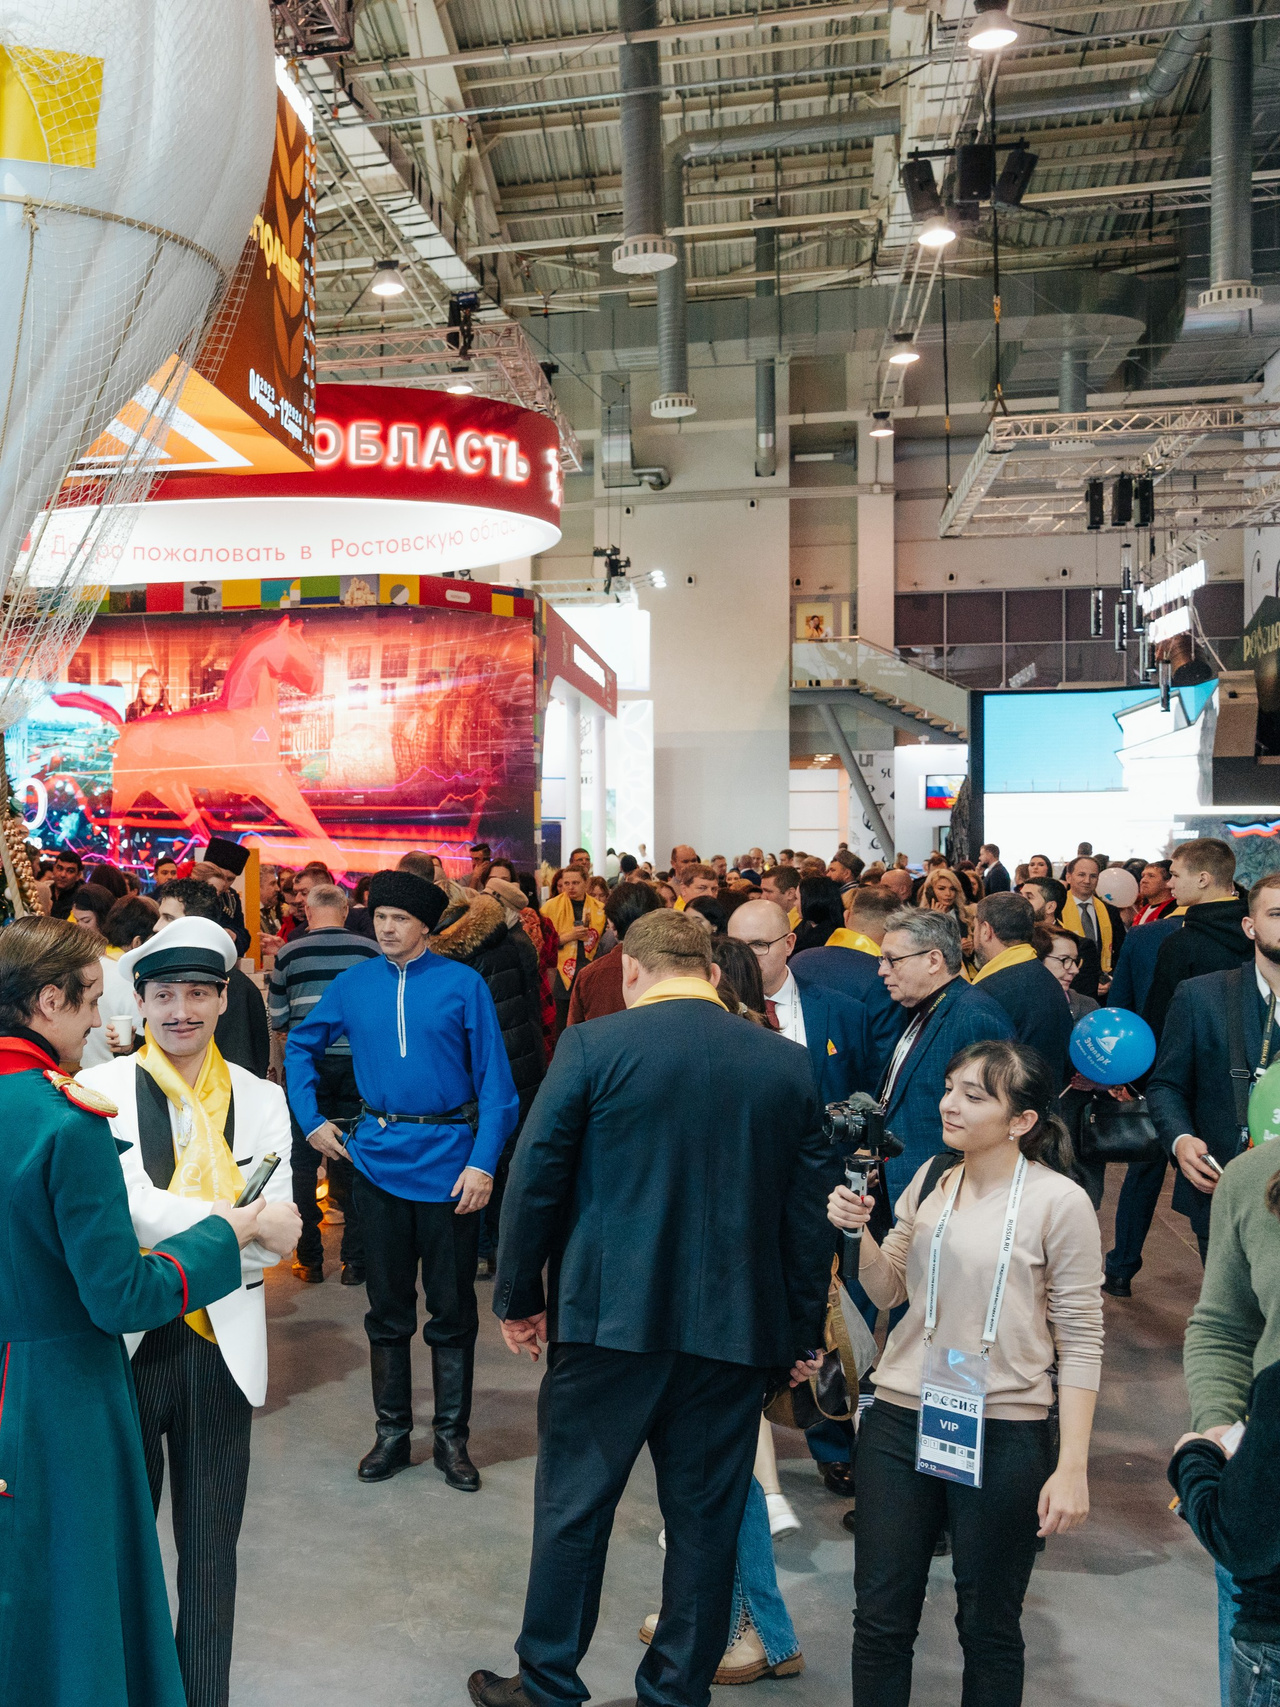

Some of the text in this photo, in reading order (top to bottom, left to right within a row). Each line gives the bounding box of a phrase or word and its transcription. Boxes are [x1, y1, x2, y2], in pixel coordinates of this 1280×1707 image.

[249, 214, 300, 293] ПОЛЬЕ
[314, 418, 532, 482] ОБЛАСТЬ
[133, 545, 286, 563] пожаловать
[300, 546, 312, 560] в
[331, 529, 464, 559] Ростовскую
[935, 1209, 949, 1238] RUSSIA.RU
[1003, 1218, 1014, 1252] RUSSIA.RU
[924, 1391, 978, 1414] РОССИЯ
[939, 1419, 959, 1432] VIP
